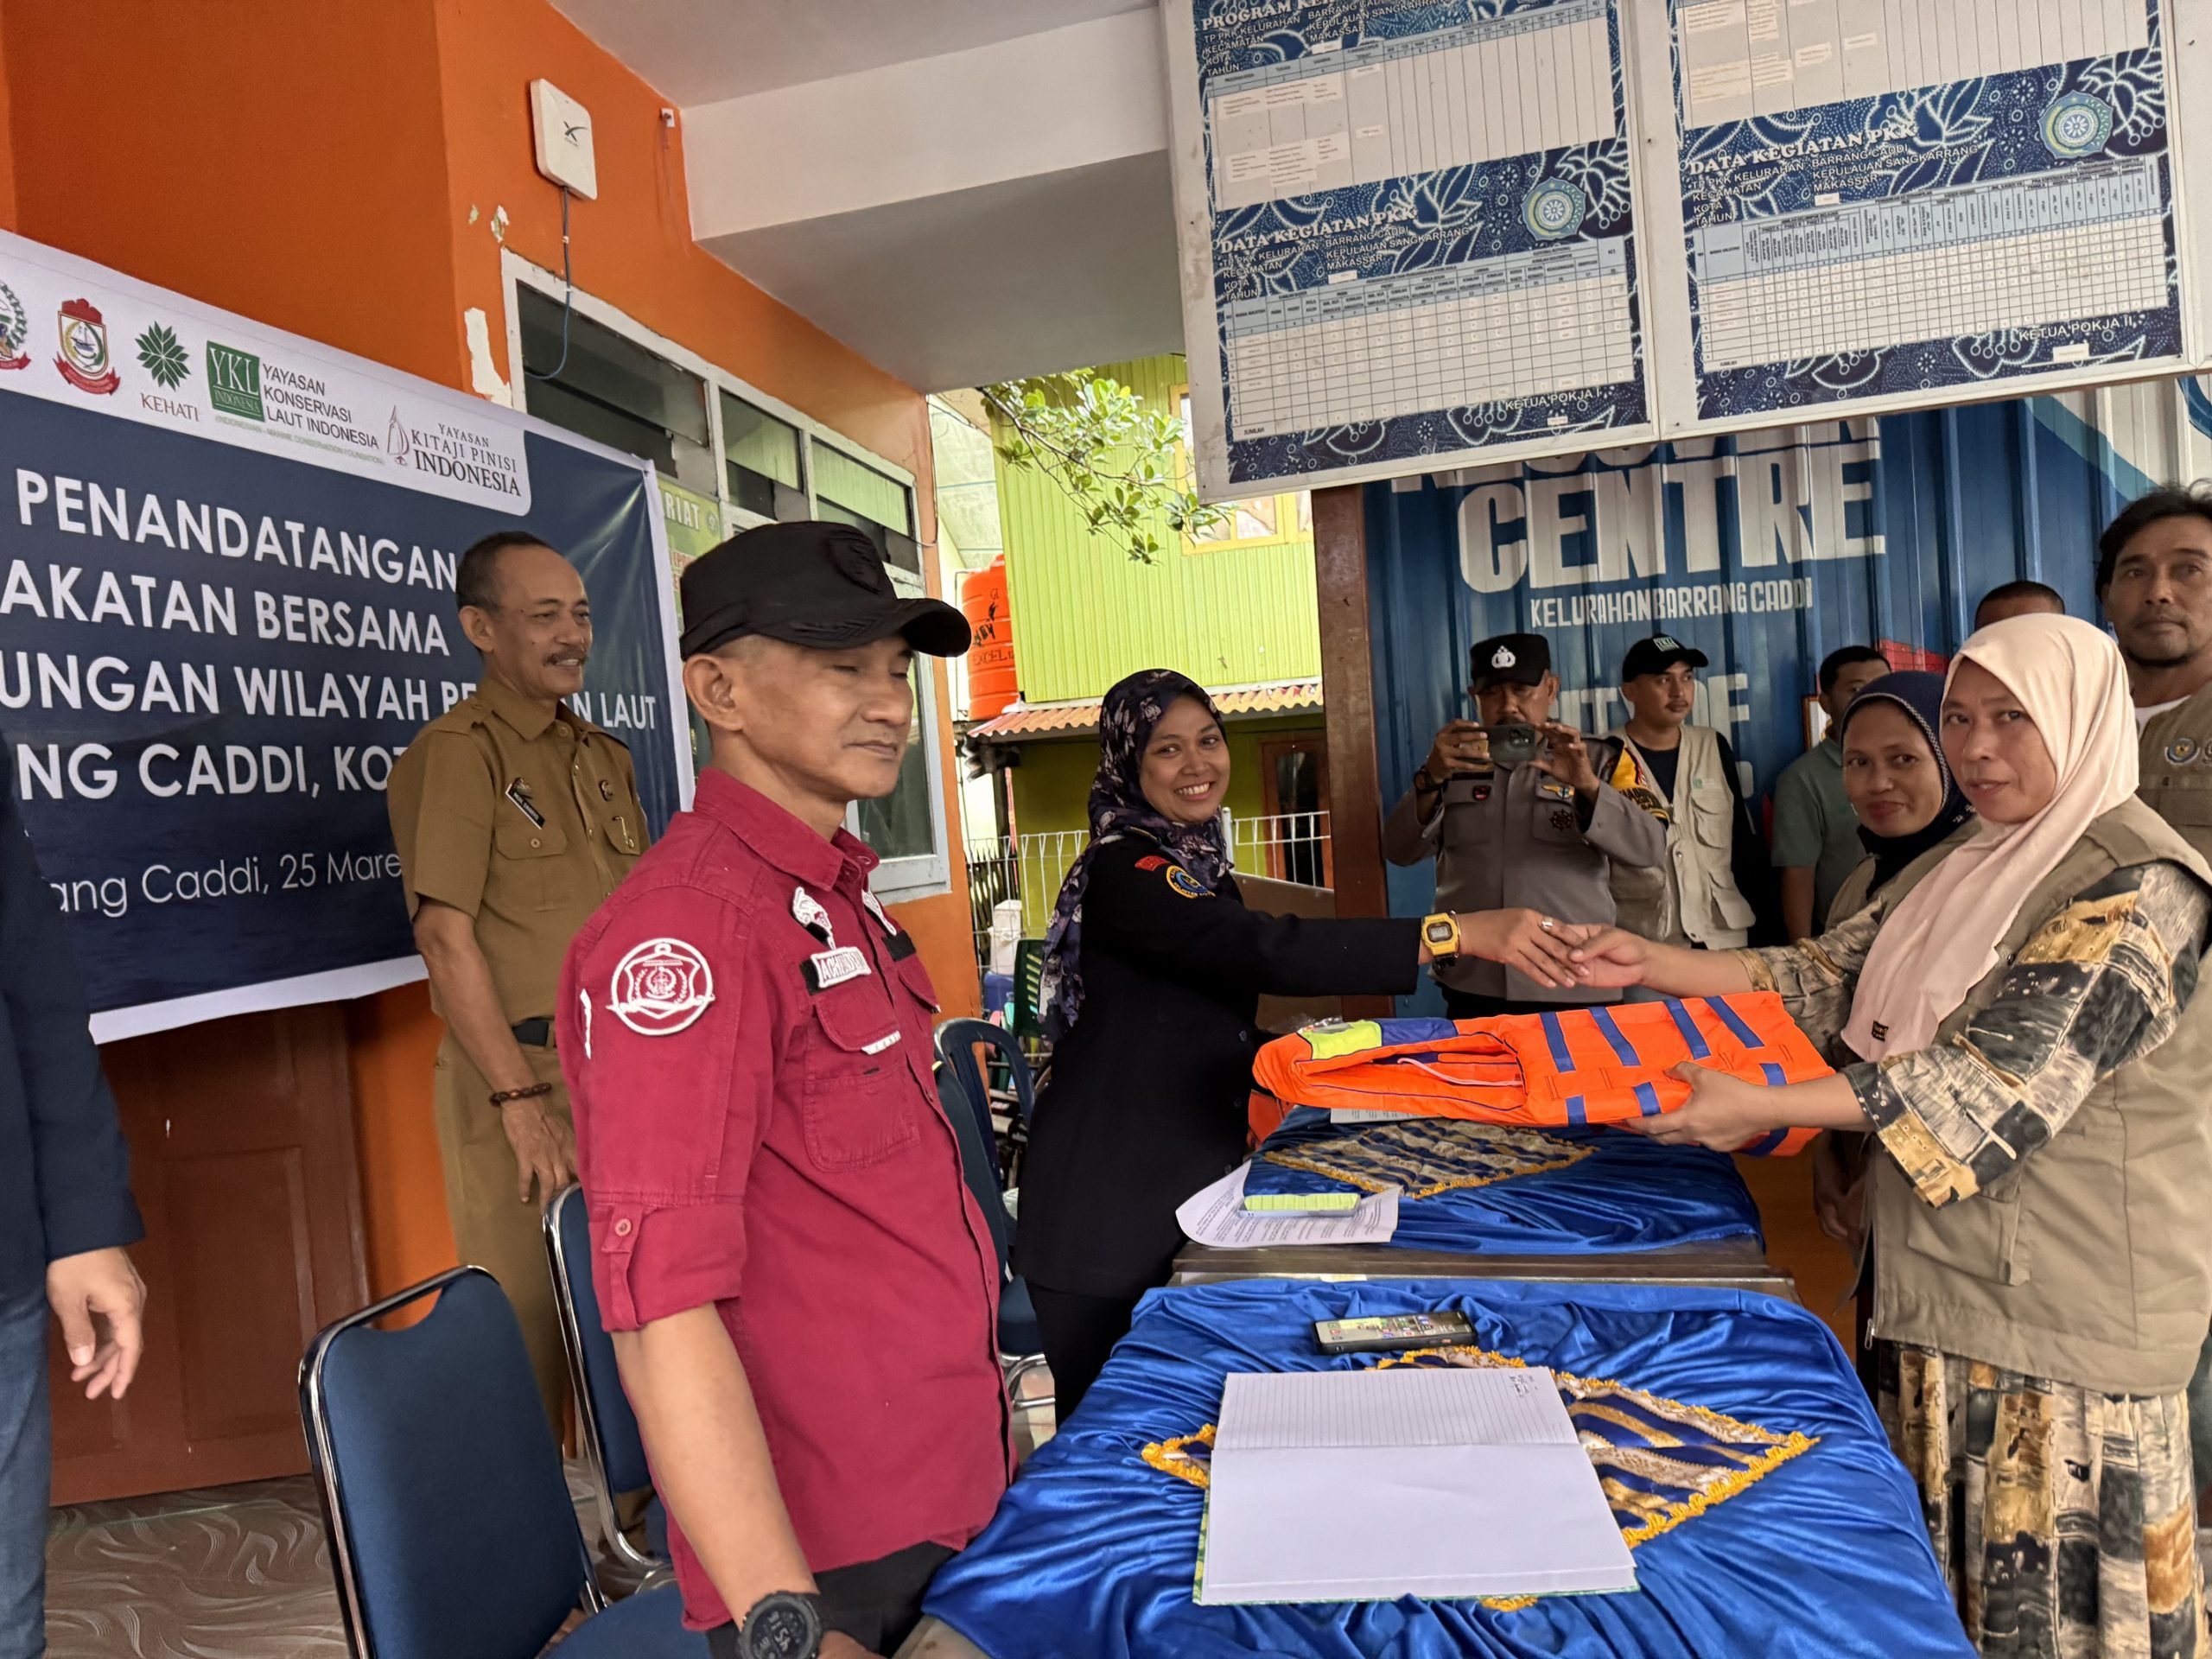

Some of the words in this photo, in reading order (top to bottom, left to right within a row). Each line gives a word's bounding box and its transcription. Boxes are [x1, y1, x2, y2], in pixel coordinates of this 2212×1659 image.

[1202, 2, 1292, 30] PROGRAM
[1205, 35, 1264, 54] KECAMATAN
[1309, 12, 1370, 31] KEPULAUAN
[1240, 16, 1300, 35] KELURAHAN
[1308, 1, 1357, 19] BARRANG
[1206, 54, 1231, 66] KOTA
[1310, 24, 1365, 42] MAKASSAR
[1688, 153, 1745, 175] DATA
[1752, 134, 1863, 163] KEGIATAN
[1868, 124, 1917, 142] PKK
[1734, 162, 1805, 182] KELURAHAN
[1812, 151, 1869, 168] BARRANG
[1872, 144, 1908, 157] CADDI
[1693, 182, 1762, 202] KECAMATAN
[1813, 161, 1884, 180] KEPULAUAN
[1885, 144, 1980, 168] SANGKARRANG
[1693, 202, 1724, 215] KOTA
[1814, 174, 1878, 192] MAKASSAR
[1220, 234, 1269, 255] DATA
[1274, 215, 1370, 243] KEGIATAN
[1374, 206, 1415, 226] PKK
[1694, 213, 1733, 226] TAHUN
[1223, 261, 1282, 279] KECAMATAN
[1326, 241, 1387, 259] KEPULAUAN
[1389, 227, 1469, 248] SANGKARRANG
[1258, 243, 1319, 261] KELURAHAN
[1325, 232, 1374, 249] BARRANG
[1377, 227, 1408, 238] CADDI
[1224, 278, 1249, 291] KOTA
[1327, 254, 1383, 271] MAKASSAR
[1224, 289, 1258, 302] TAHUN
[2019, 326, 2068, 341] KETUA
[2071, 318, 2120, 334] POKJA
[2124, 315, 2133, 327] II
[210, 347, 259, 395] YKL
[263, 363, 326, 397] YAYASAN
[140, 392, 200, 422] KEHATI
[215, 391, 260, 413] INDONESIA
[264, 385, 353, 423] KONSERVASI
[1505, 397, 1547, 410] KETUA
[1550, 390, 1592, 404] POKJA
[266, 406, 303, 429] LAUT
[306, 417, 379, 449] INDONESIA
[438, 423, 490, 448] YAYASAN
[411, 429, 466, 459] KITAJI
[472, 448, 517, 474] PINISI
[414, 449, 522, 497] INDONESIA
[16, 468, 457, 593] PENANDATANGAN
[1458, 436, 1886, 594] CENTRE
[0, 559, 238, 636] AKATAN
[254, 591, 450, 657] BERSAMA
[1530, 588, 1651, 628] KELURAHAN
[1653, 581, 1747, 620] BARRANG
[1750, 577, 1814, 613] CADDI
[233, 666, 429, 721] WILAYAH
[600, 692, 656, 730] LAUT
[138, 743, 321, 799] CADDI,
[142, 855, 270, 904] Caddi,
[280, 853, 317, 889] 25
